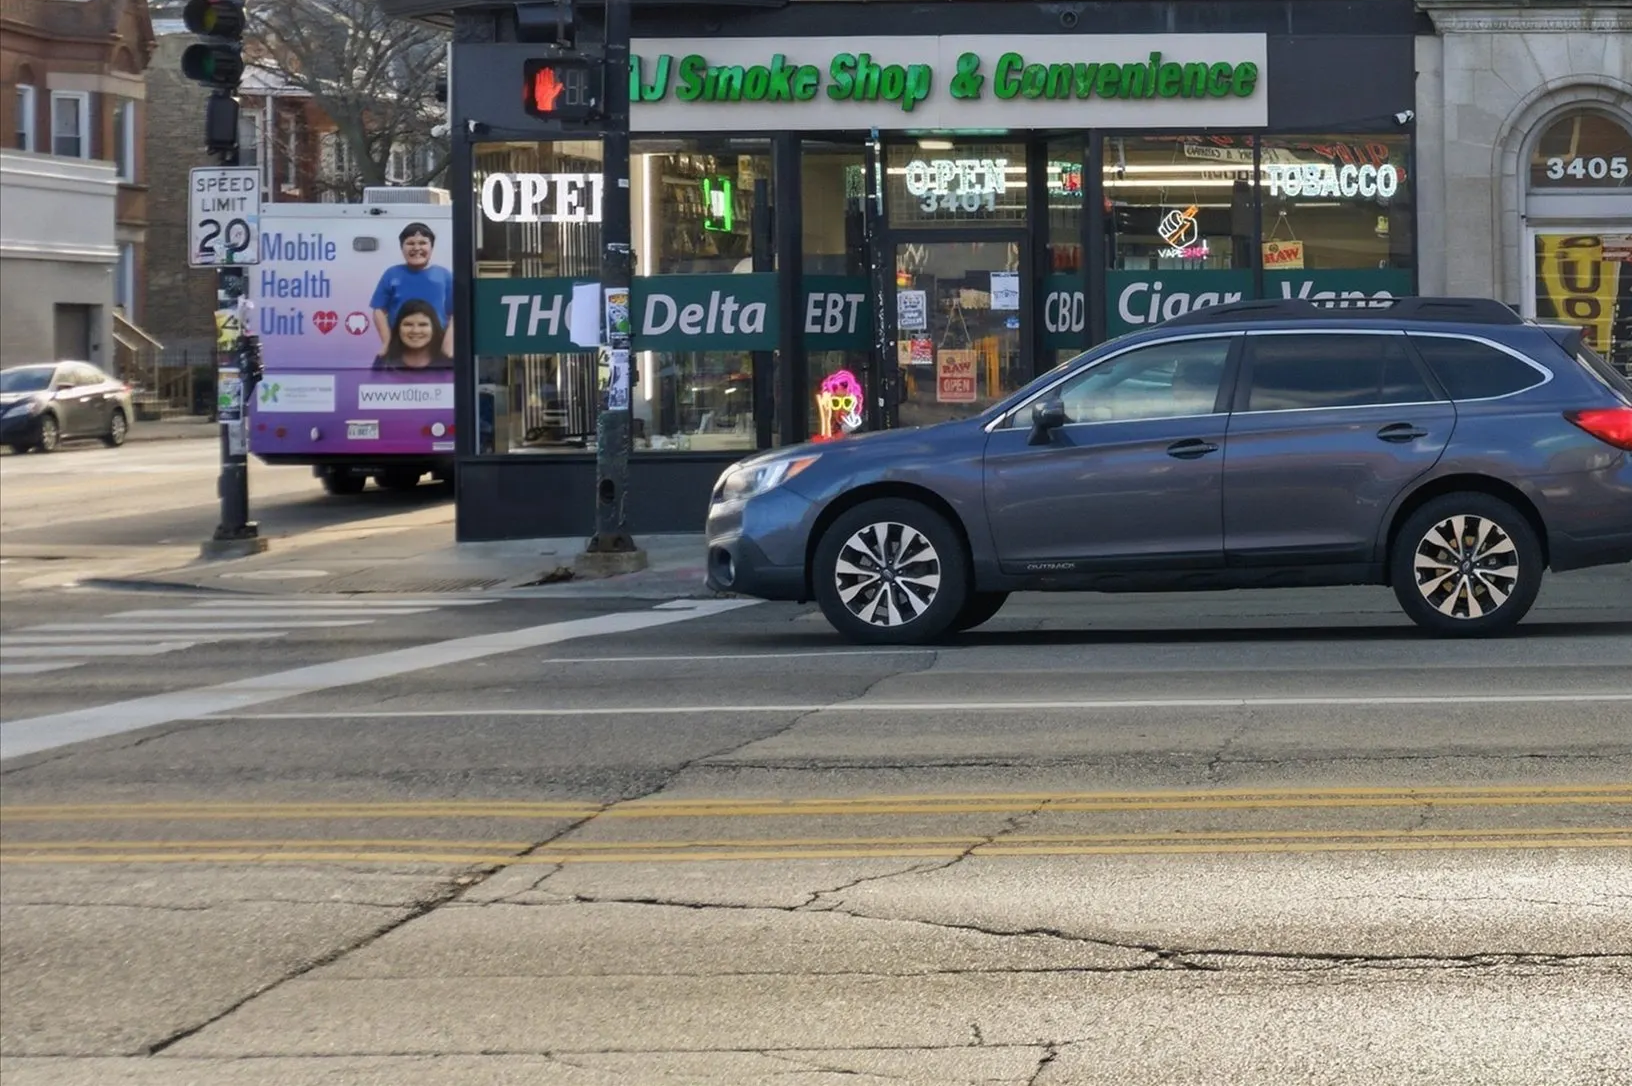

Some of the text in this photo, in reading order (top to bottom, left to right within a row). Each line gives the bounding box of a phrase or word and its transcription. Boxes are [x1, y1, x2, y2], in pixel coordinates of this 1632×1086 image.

[675, 53, 820, 102] Smoke
[826, 52, 933, 112] Shop
[950, 51, 985, 100] &
[993, 51, 1259, 100] Convenience
[905, 158, 1008, 196] OPEN
[1266, 164, 1398, 198] TOBACCO
[1546, 157, 1629, 180] 3405
[195, 177, 255, 192] SPEED
[201, 197, 248, 212] LIMIT
[919, 190, 996, 213] 3401
[198, 218, 250, 253] 20
[261, 232, 336, 261] Mobile
[1264, 247, 1299, 264] RAW
[261, 270, 331, 298] Health
[260, 307, 305, 336] Unit
[500, 295, 573, 336] TH
[642, 290, 767, 335] Delta
[804, 292, 865, 334] EBT
[1044, 291, 1085, 333] CBD
[942, 361, 971, 374] RAW
[943, 378, 971, 393] OPEN
